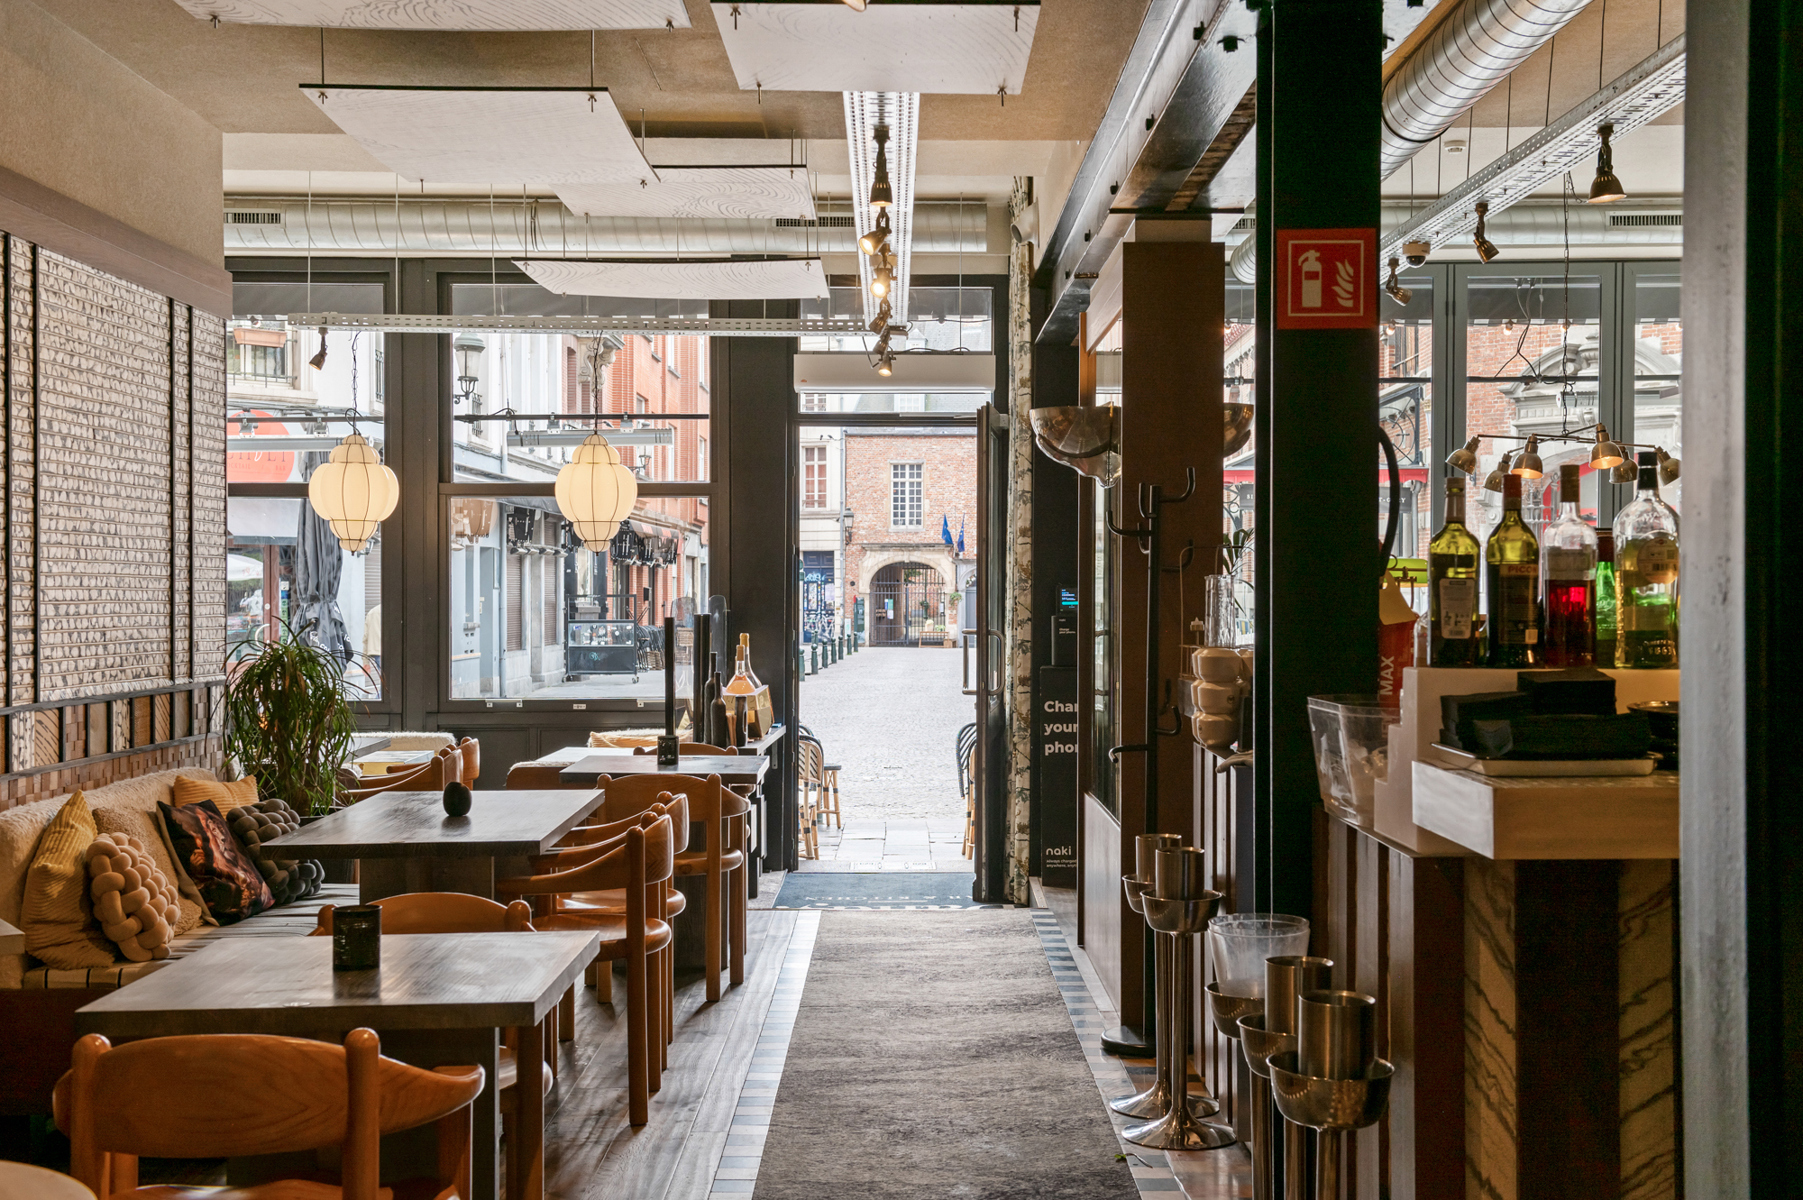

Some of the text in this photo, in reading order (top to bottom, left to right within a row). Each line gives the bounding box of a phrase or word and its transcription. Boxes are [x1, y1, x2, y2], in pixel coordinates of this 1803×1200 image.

[1380, 656, 1395, 695] MAX
[1044, 723, 1078, 735] your
[1046, 846, 1071, 855] naki
